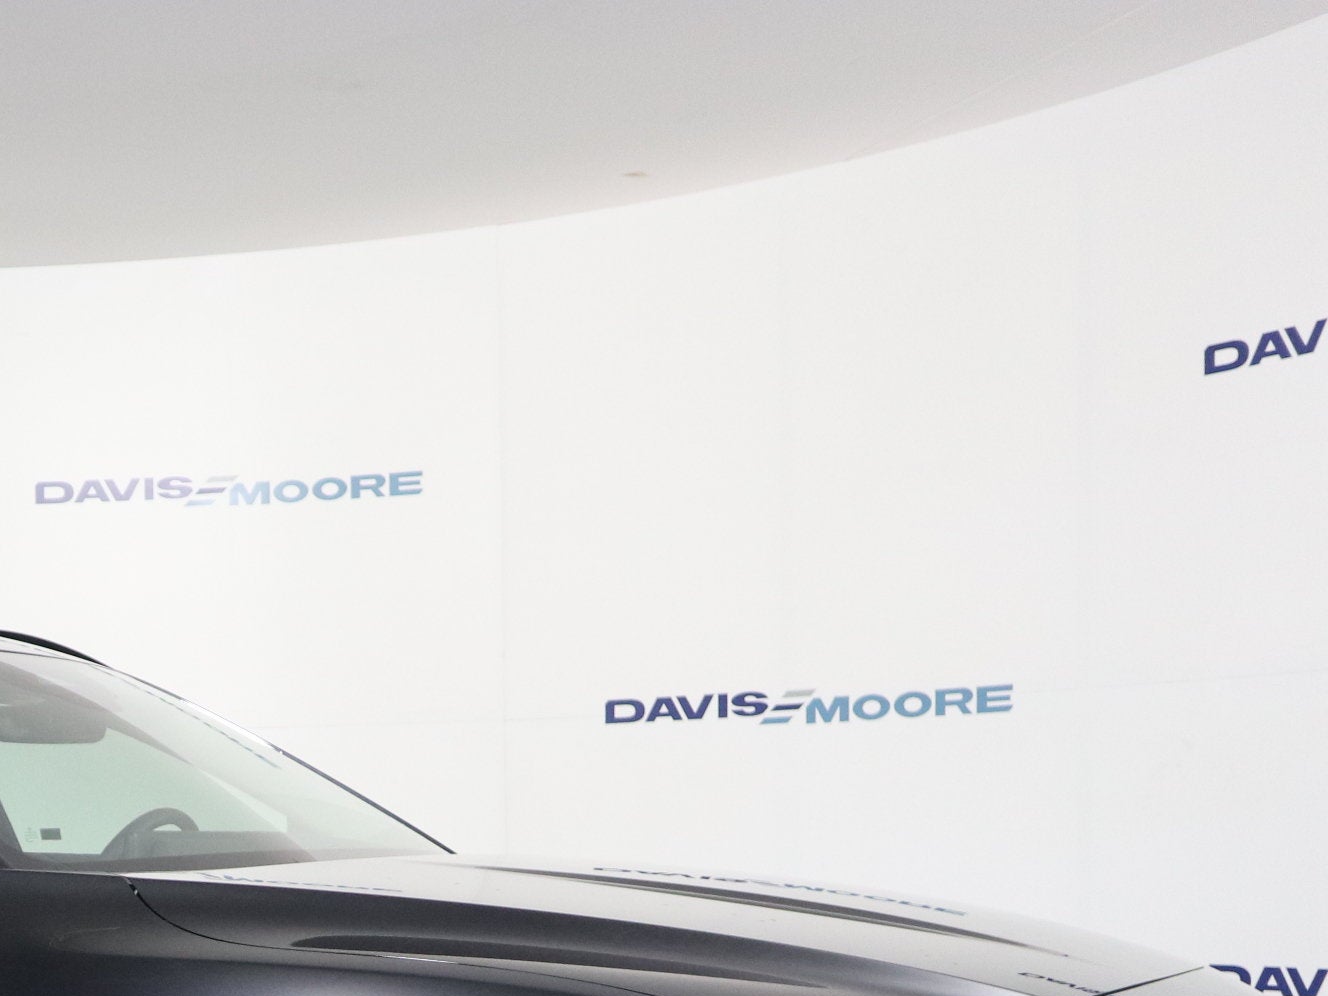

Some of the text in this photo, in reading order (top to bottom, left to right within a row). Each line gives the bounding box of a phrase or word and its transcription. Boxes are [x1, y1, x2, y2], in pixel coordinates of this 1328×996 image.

[34, 470, 424, 505] DAVIS MOORE
[604, 683, 1014, 725] DAVIS MOORE
